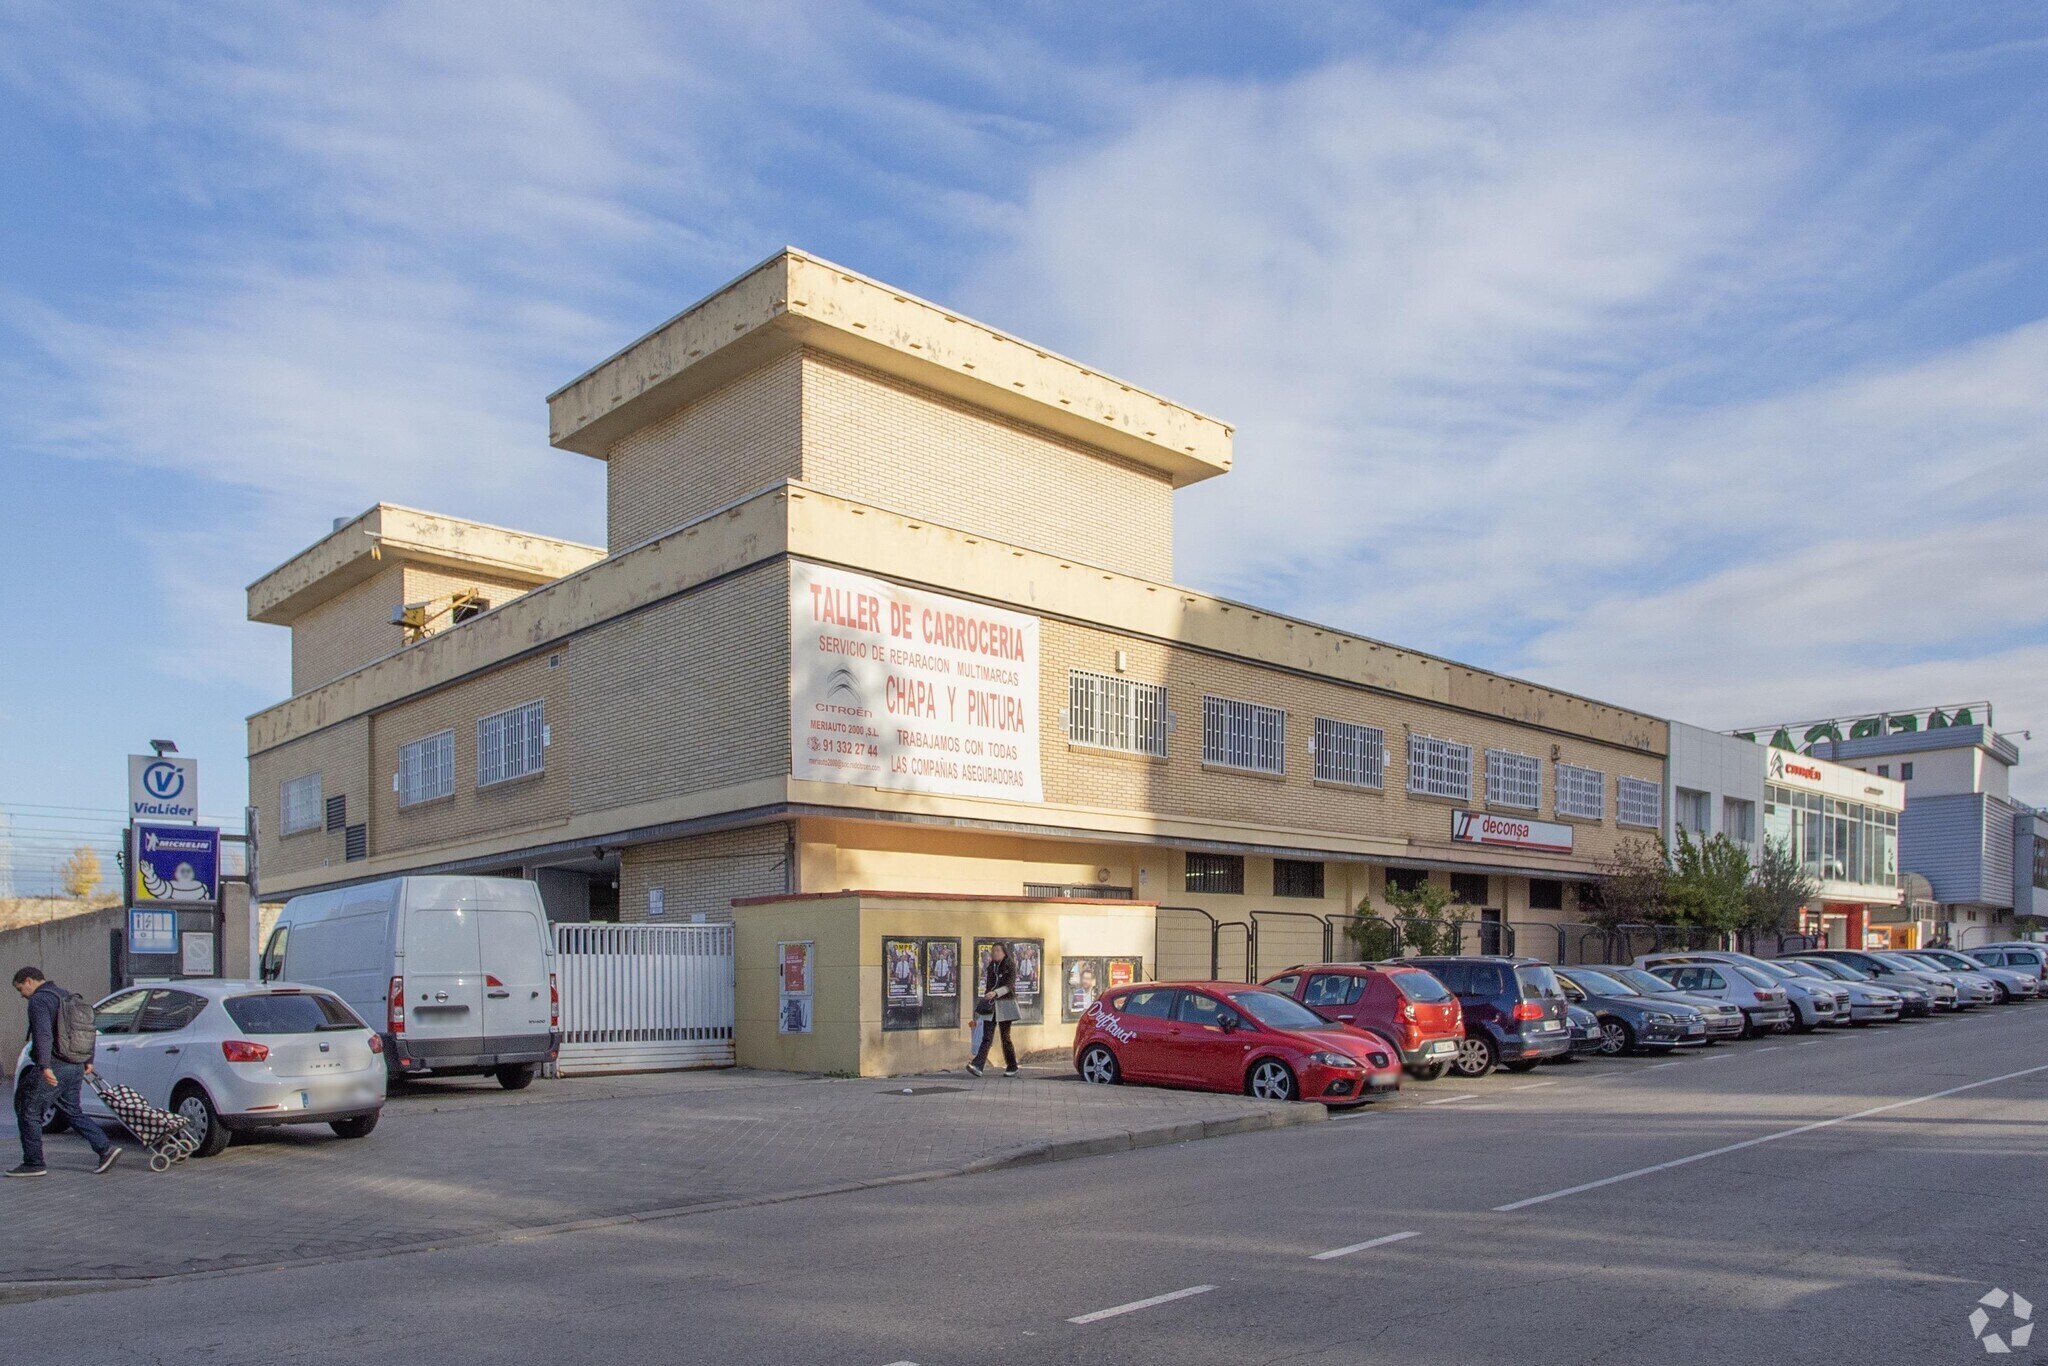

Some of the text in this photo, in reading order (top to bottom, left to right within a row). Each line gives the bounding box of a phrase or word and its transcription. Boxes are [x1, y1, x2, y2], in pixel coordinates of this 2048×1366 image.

[810, 583, 1024, 662] TALLER DE CARROCERIA
[819, 635, 1019, 686] SERVICIO DE REPARACION MULTIMARCAS
[886, 674, 1025, 733] CHAPA Y PINTURA
[810, 719, 847, 733] MERIAUTO
[848, 724, 864, 735] 2000
[823, 738, 878, 757] 91 332 27 44
[897, 729, 1018, 760] TRABAJAMOS CON TODAS
[891, 755, 1024, 787] LAS COMPAÑIAS ASEGURADORAS
[1482, 815, 1530, 838] deconsa
[159, 840, 209, 849] MICHELIN
[1063, 889, 1071, 898] 12
